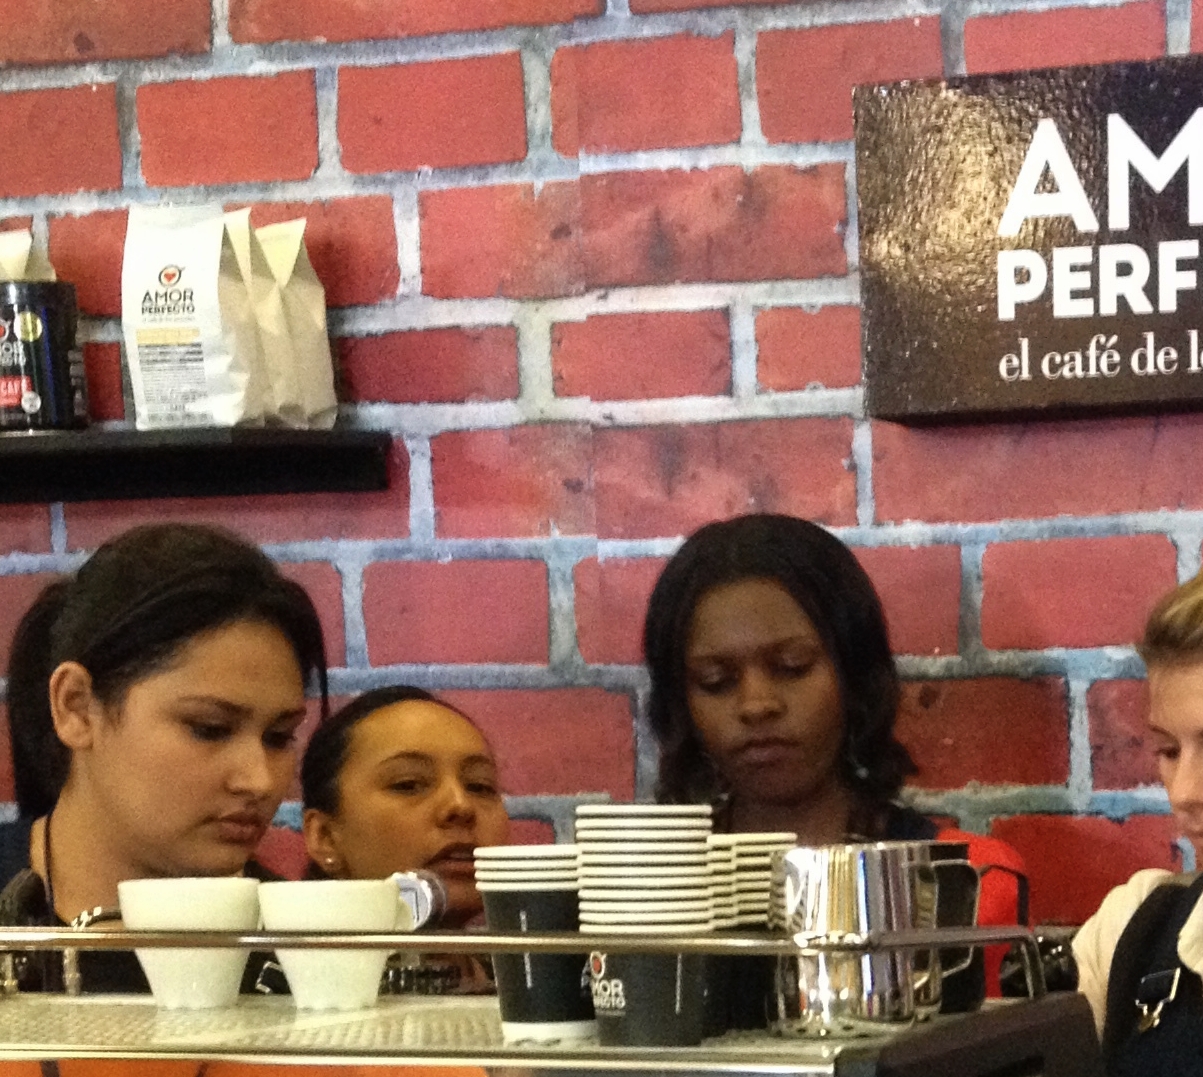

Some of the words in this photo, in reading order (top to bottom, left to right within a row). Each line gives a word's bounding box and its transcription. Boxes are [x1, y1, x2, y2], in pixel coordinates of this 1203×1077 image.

[142, 287, 194, 304] AMOR
[999, 338, 1030, 381] el
[1041, 332, 1121, 379] café
[1131, 331, 1179, 374] de
